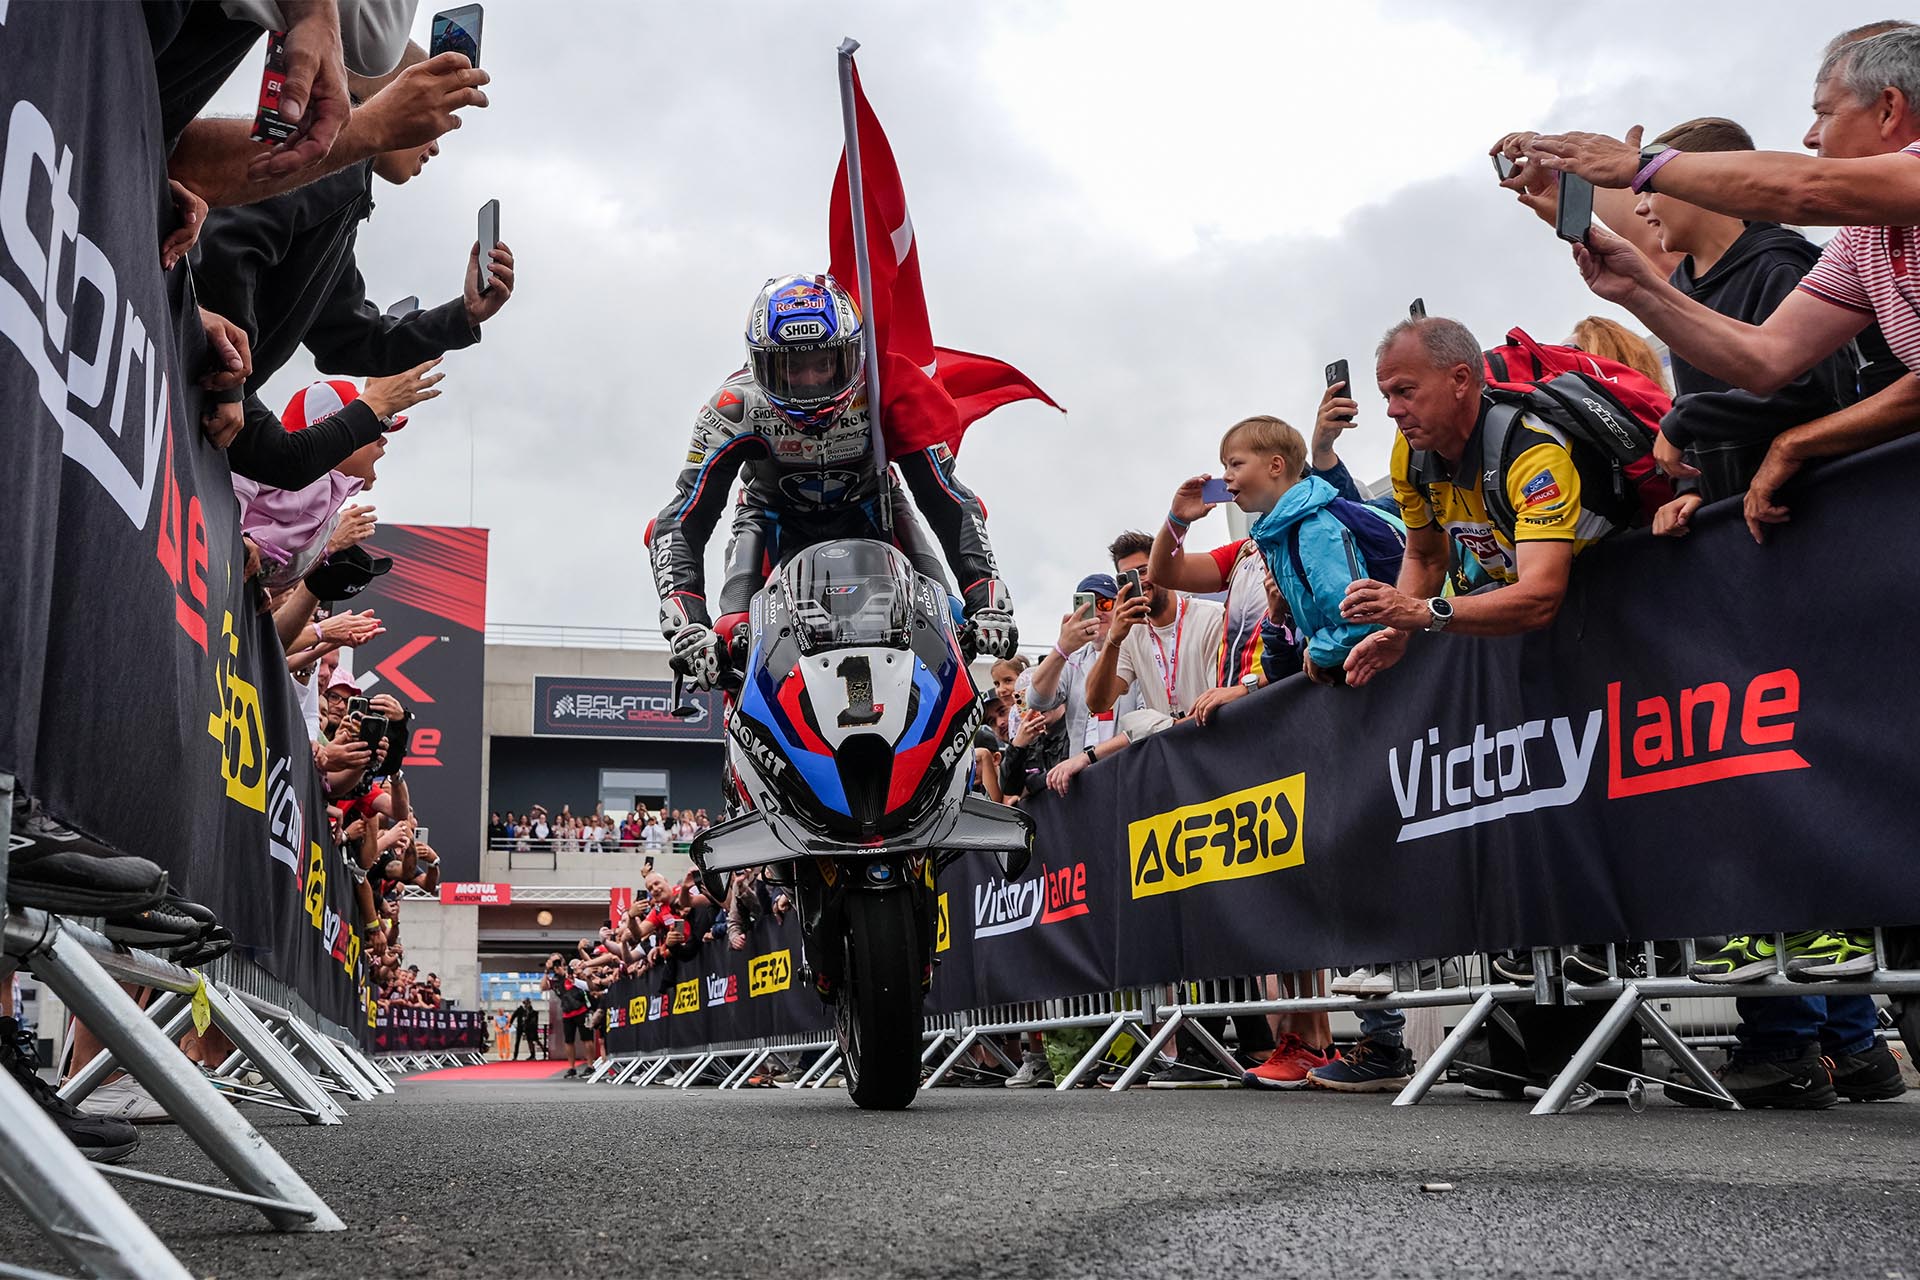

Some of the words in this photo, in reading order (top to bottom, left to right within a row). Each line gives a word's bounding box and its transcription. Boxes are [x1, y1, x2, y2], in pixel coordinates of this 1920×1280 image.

[802, 297, 825, 310] Bull
[785, 323, 820, 337] SHOEI
[765, 345, 790, 353] GIVES
[794, 344, 814, 352] YOU
[818, 339, 848, 350] WINGS
[790, 395, 831, 404] PROMETEON
[753, 408, 777, 420] SHOE
[840, 409, 871, 429] ROK
[1582, 396, 1636, 450] alpinestars
[1462, 537, 1497, 554] PAT
[656, 532, 675, 596] ROKi
[836, 655, 884, 729] 1
[576, 709, 625, 721] PARK
[730, 711, 787, 777] ROKiT
[857, 847, 888, 855] OUTDO
[455, 883, 497, 894] MOTUL
